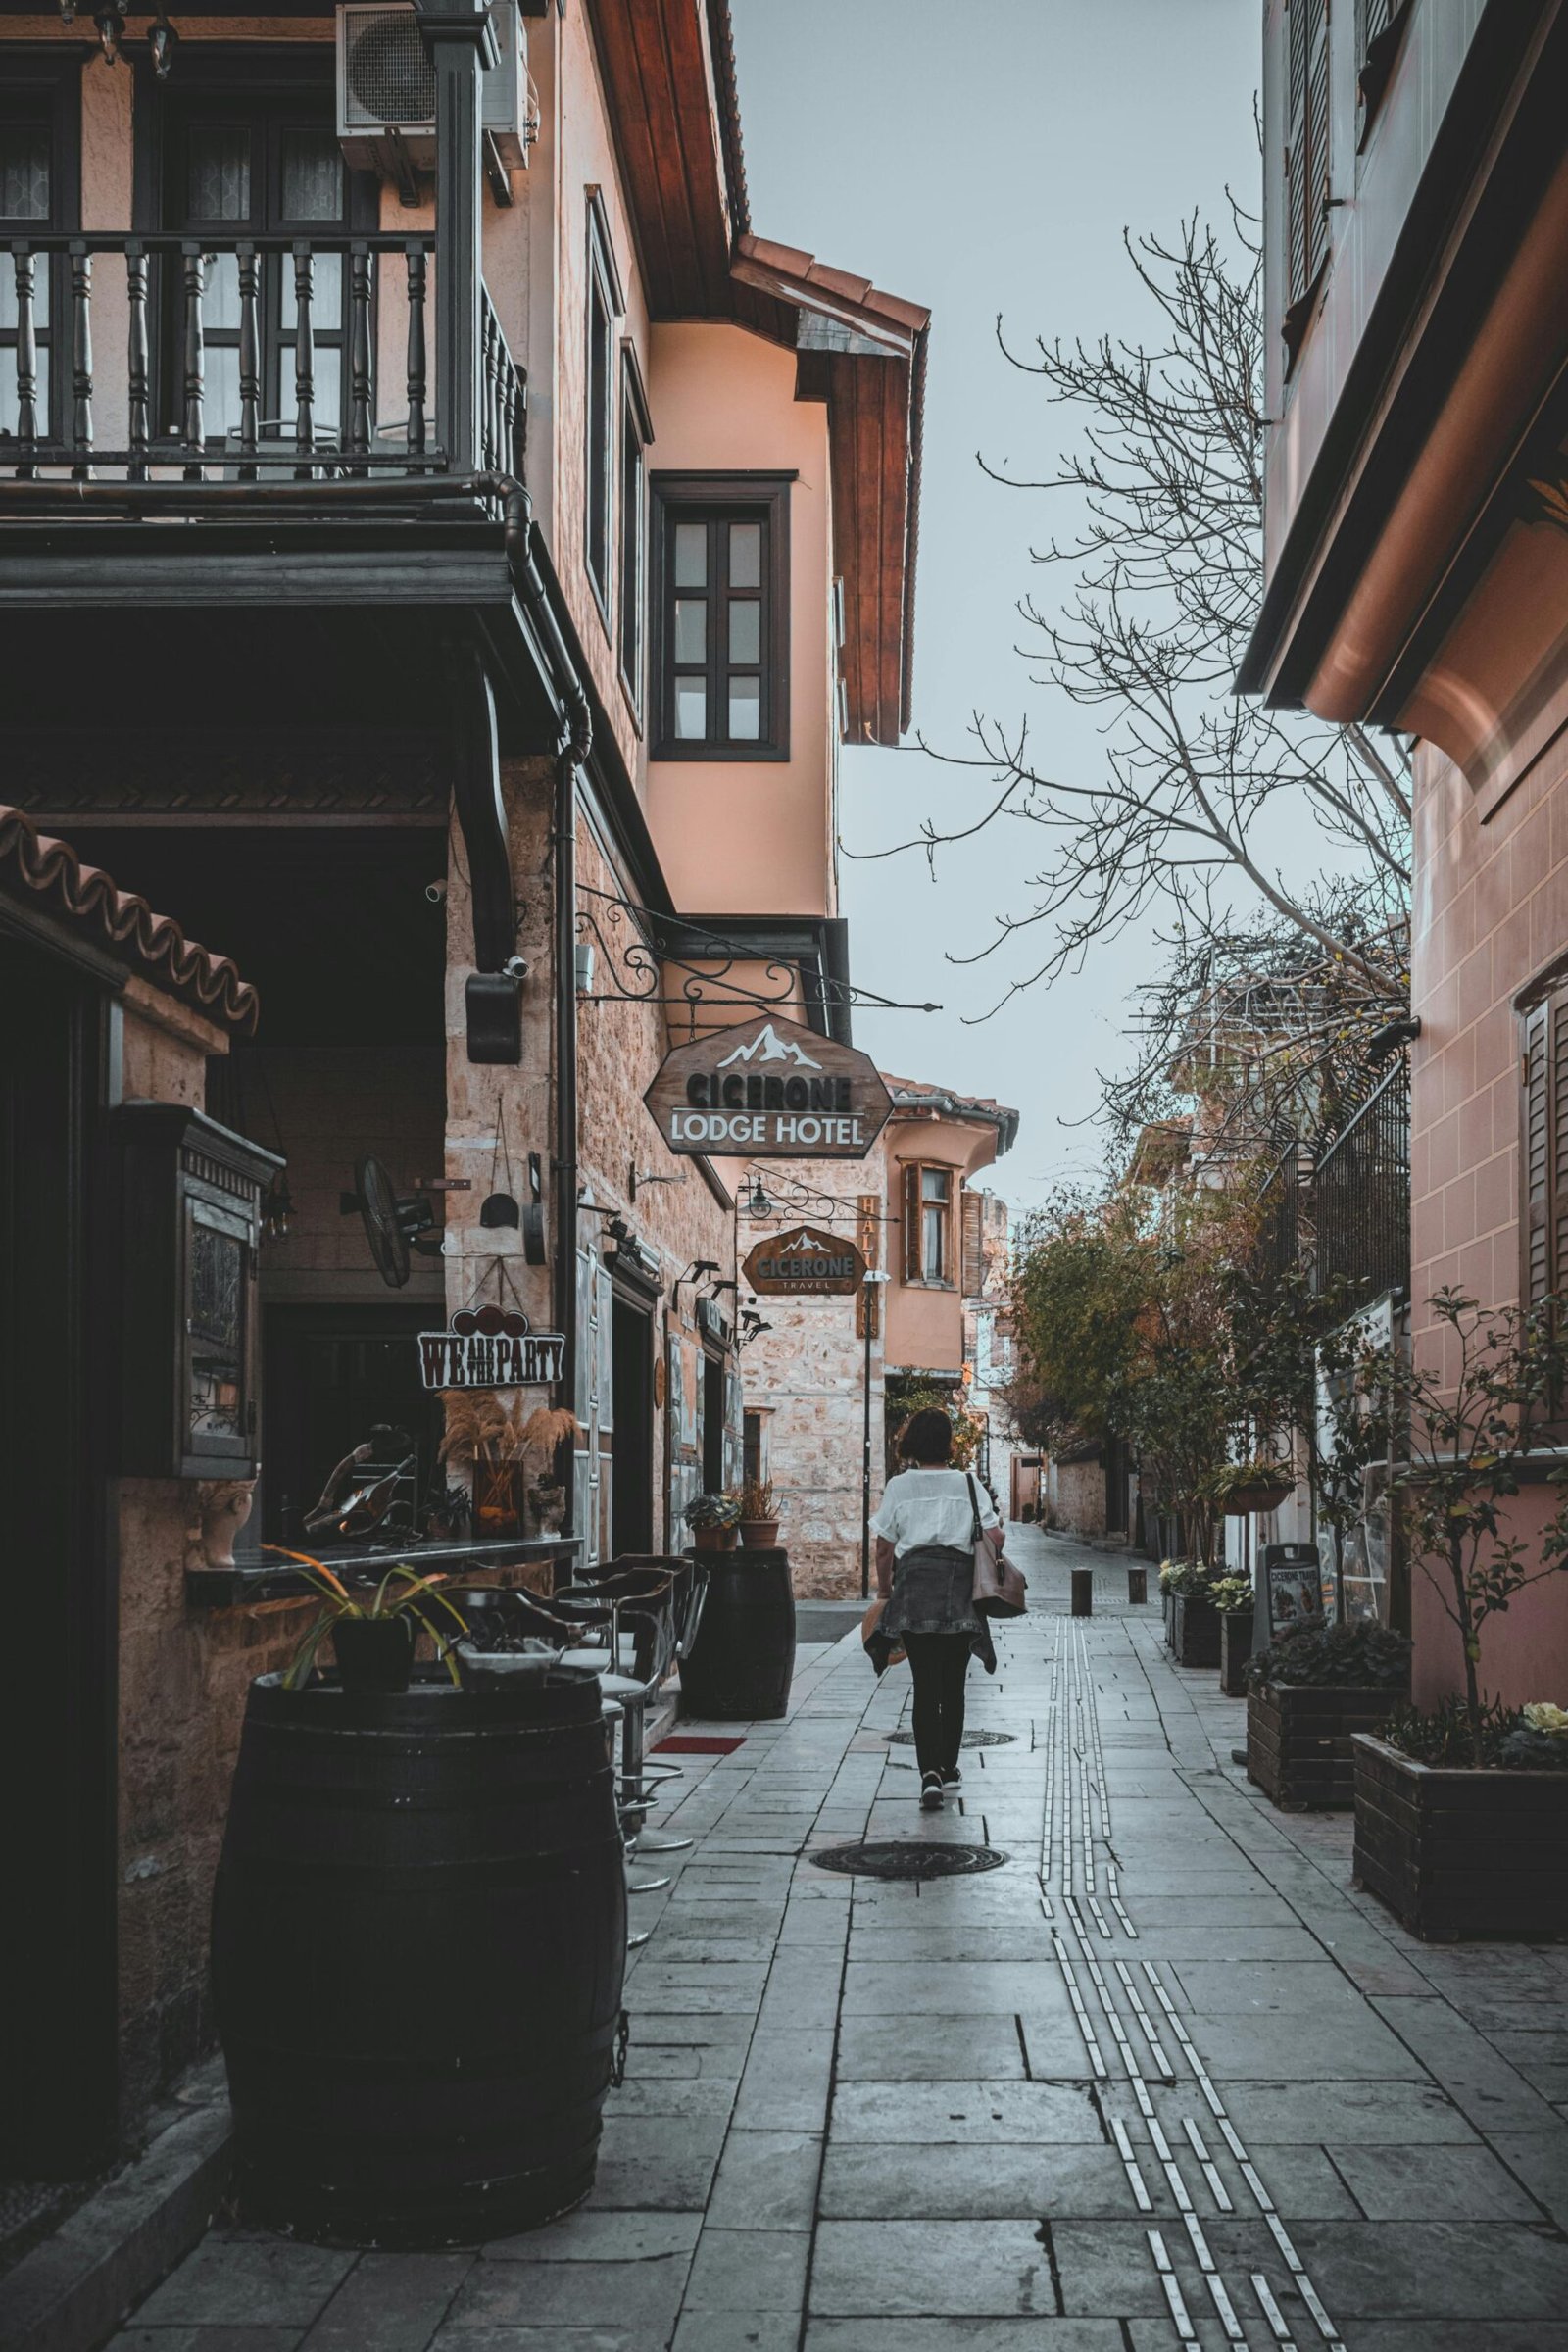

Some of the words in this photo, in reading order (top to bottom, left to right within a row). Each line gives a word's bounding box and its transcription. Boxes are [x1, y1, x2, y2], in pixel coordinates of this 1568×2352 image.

[687, 1073, 852, 1113] CICERONE
[671, 1114, 766, 1143] LODGE
[776, 1116, 864, 1145] HOTEL
[757, 1257, 854, 1278] CICERONE
[783, 1281, 831, 1290] TRAVEL
[420, 1336, 466, 1387] WE
[467, 1337, 495, 1361] ARE
[496, 1338, 564, 1384] PARTY
[467, 1361, 495, 1384] THE
